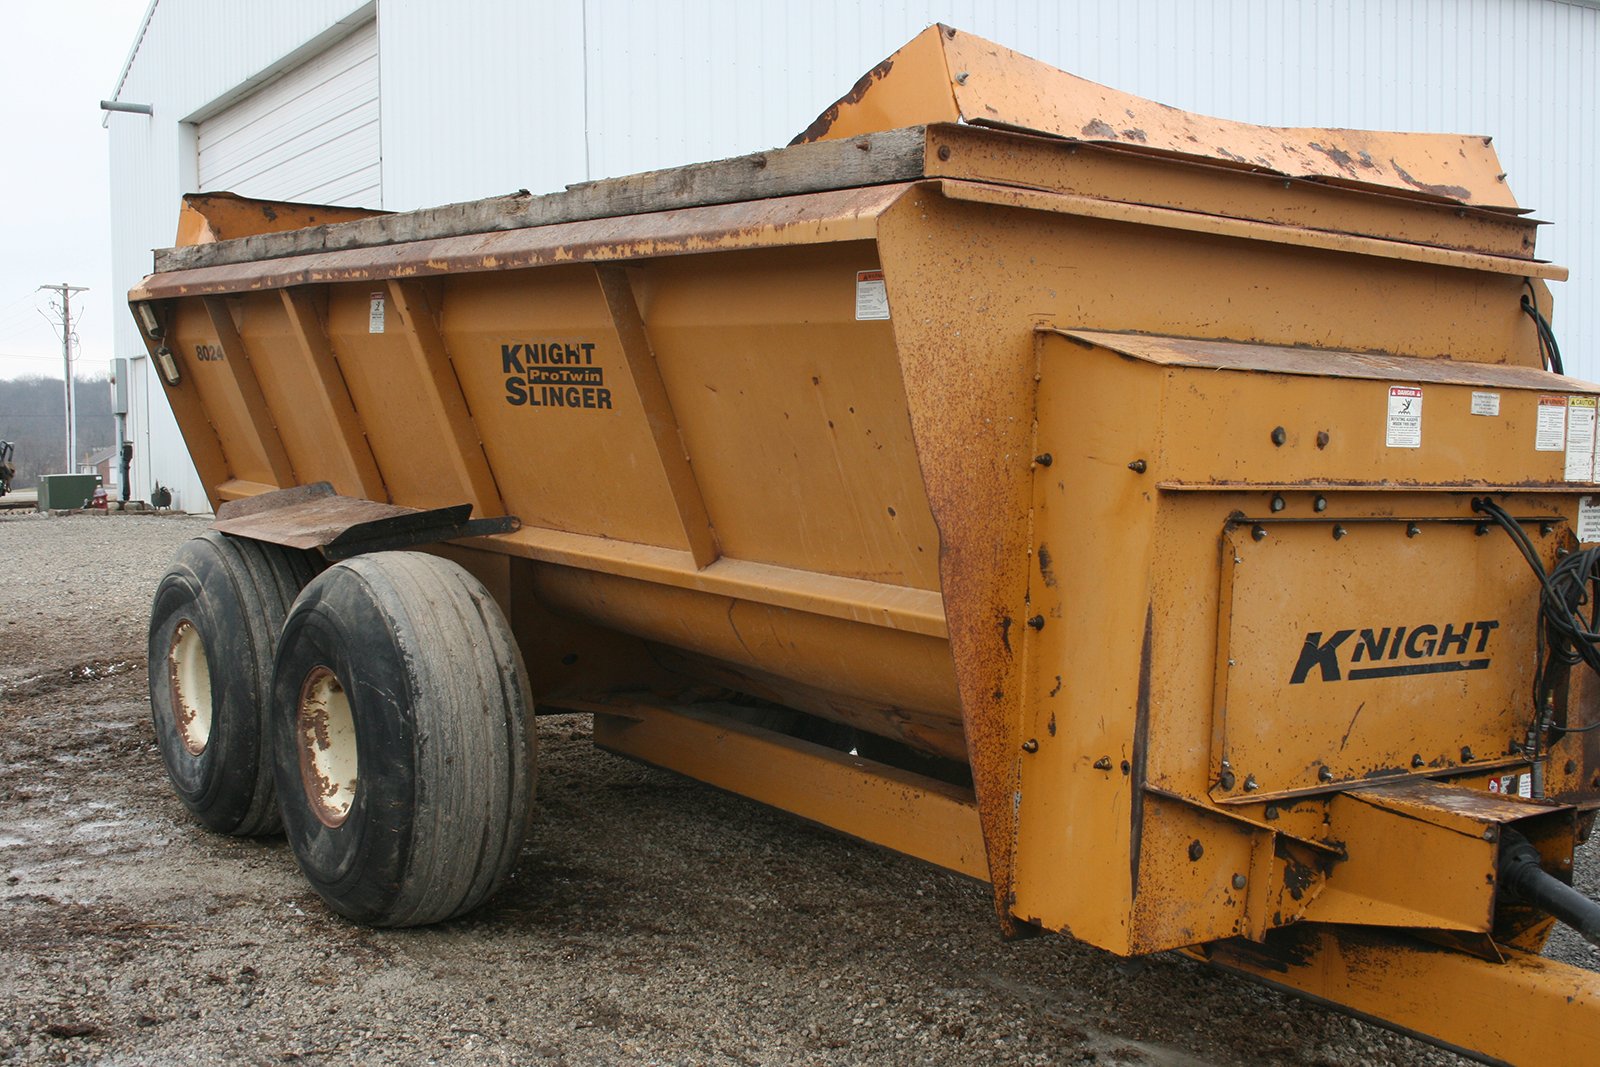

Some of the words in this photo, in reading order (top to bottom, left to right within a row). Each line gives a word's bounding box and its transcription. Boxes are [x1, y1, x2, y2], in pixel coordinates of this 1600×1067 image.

[502, 343, 595, 373] KNIGHT
[529, 369, 600, 382] ProTwin
[505, 376, 612, 409] SLINGER
[1289, 620, 1500, 685] KNIGHT
